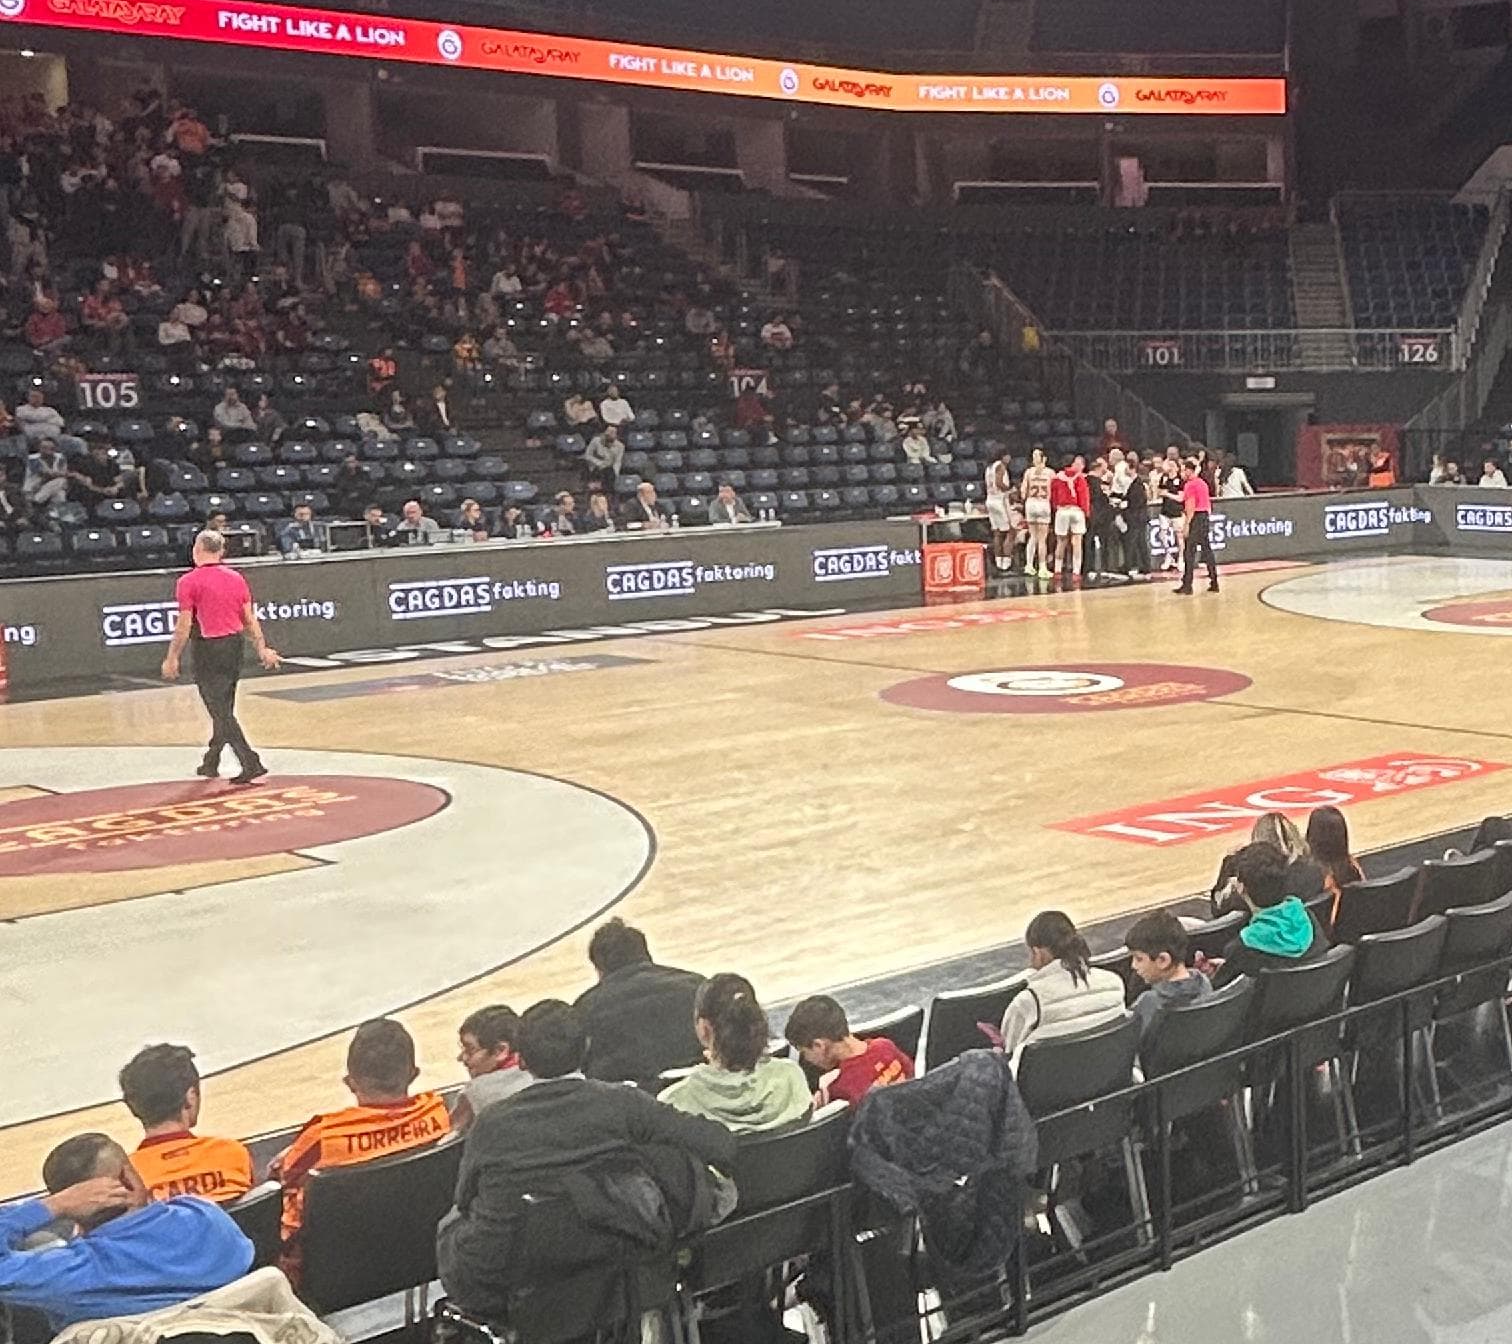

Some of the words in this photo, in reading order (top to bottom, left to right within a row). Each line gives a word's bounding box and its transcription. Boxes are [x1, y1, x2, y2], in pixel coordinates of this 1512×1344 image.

[217, 10, 281, 33] FIGHT
[286, 18, 333, 40] LIKE
[336, 24, 352, 41] A
[355, 26, 406, 46] LION
[609, 53, 656, 73] FIGHT
[661, 58, 698, 77] LIKE
[700, 64, 712, 78] A
[716, 66, 755, 82] LION
[918, 84, 968, 100] FIGHT
[972, 85, 1008, 101] LIKE
[1012, 87, 1025, 101] A
[1028, 86, 1071, 101] LION
[1146, 347, 1182, 365] 101
[1400, 344, 1438, 363] 126
[80, 381, 139, 409] 105
[1225, 517, 1292, 537] faktoring
[1324, 508, 1388, 532] CAGDAS
[1457, 511, 1512, 526] CAGDAS
[814, 551, 889, 573] CAGDAS
[607, 567, 694, 594] CAGDAS
[695, 563, 774, 585] faktoring
[388, 583, 491, 613] CAGDAS
[102, 611, 181, 638] CAGD
[252, 599, 336, 621] ktoring
[0, 787, 341, 853] AGDAS
[1088, 785, 1355, 843] ING
[344, 1115, 442, 1155] TORREIRA
[152, 1169, 226, 1201] CARDI
